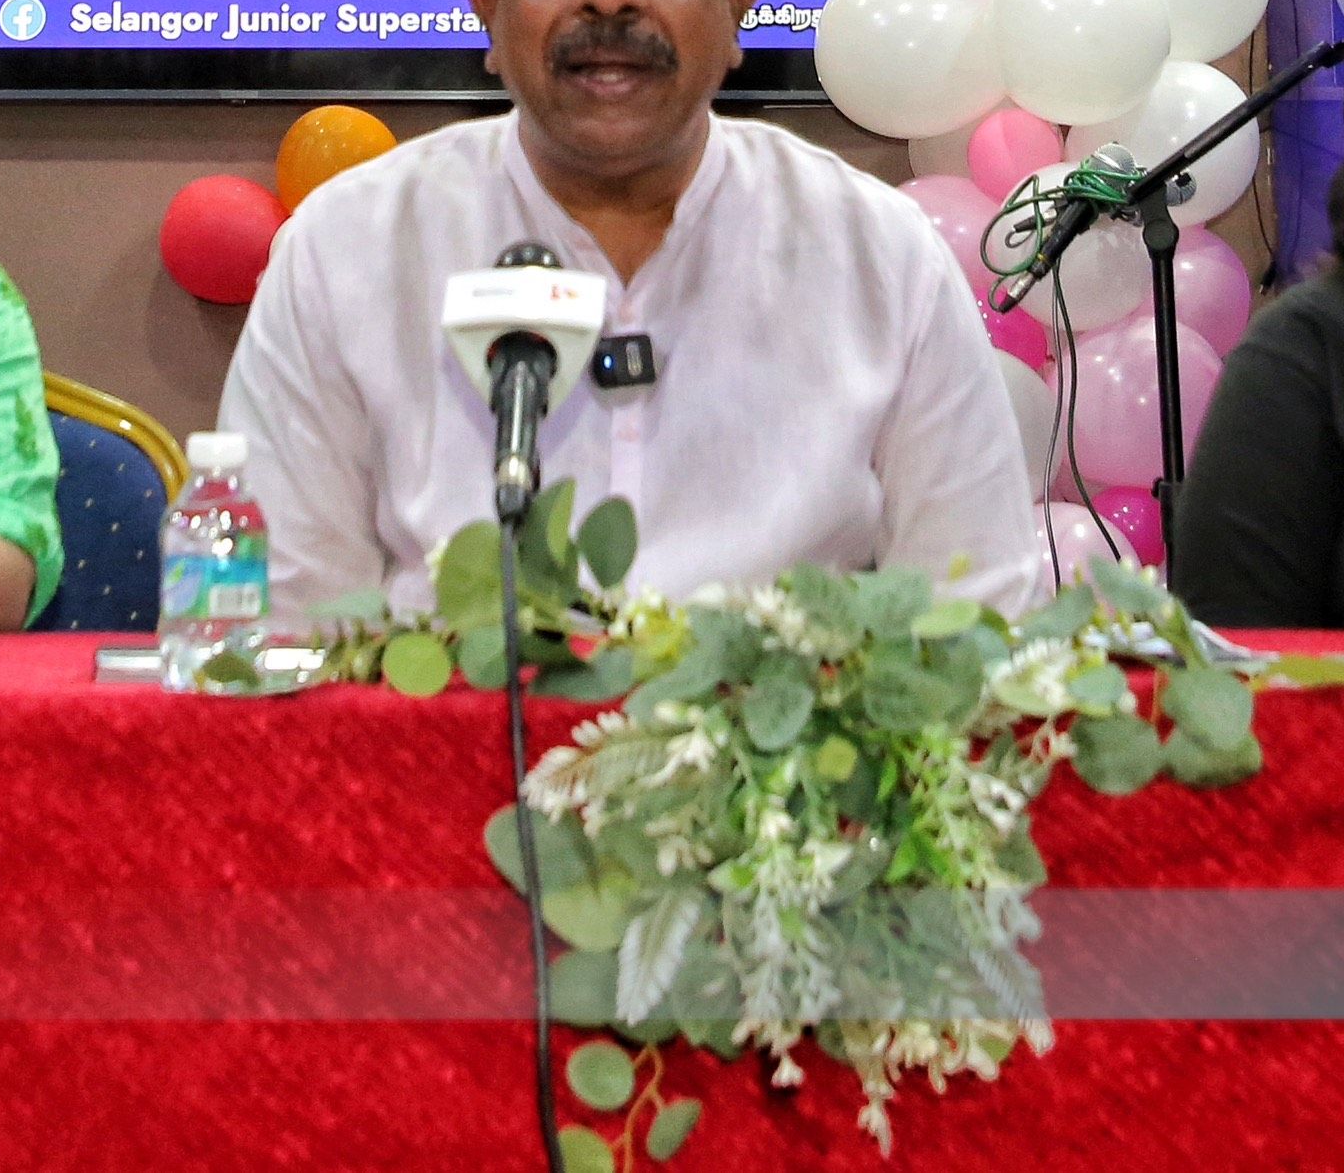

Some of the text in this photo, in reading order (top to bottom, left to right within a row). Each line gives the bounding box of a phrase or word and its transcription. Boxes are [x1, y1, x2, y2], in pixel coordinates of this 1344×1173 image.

[69, 3, 488, 40] Selangor Junior Supersta
